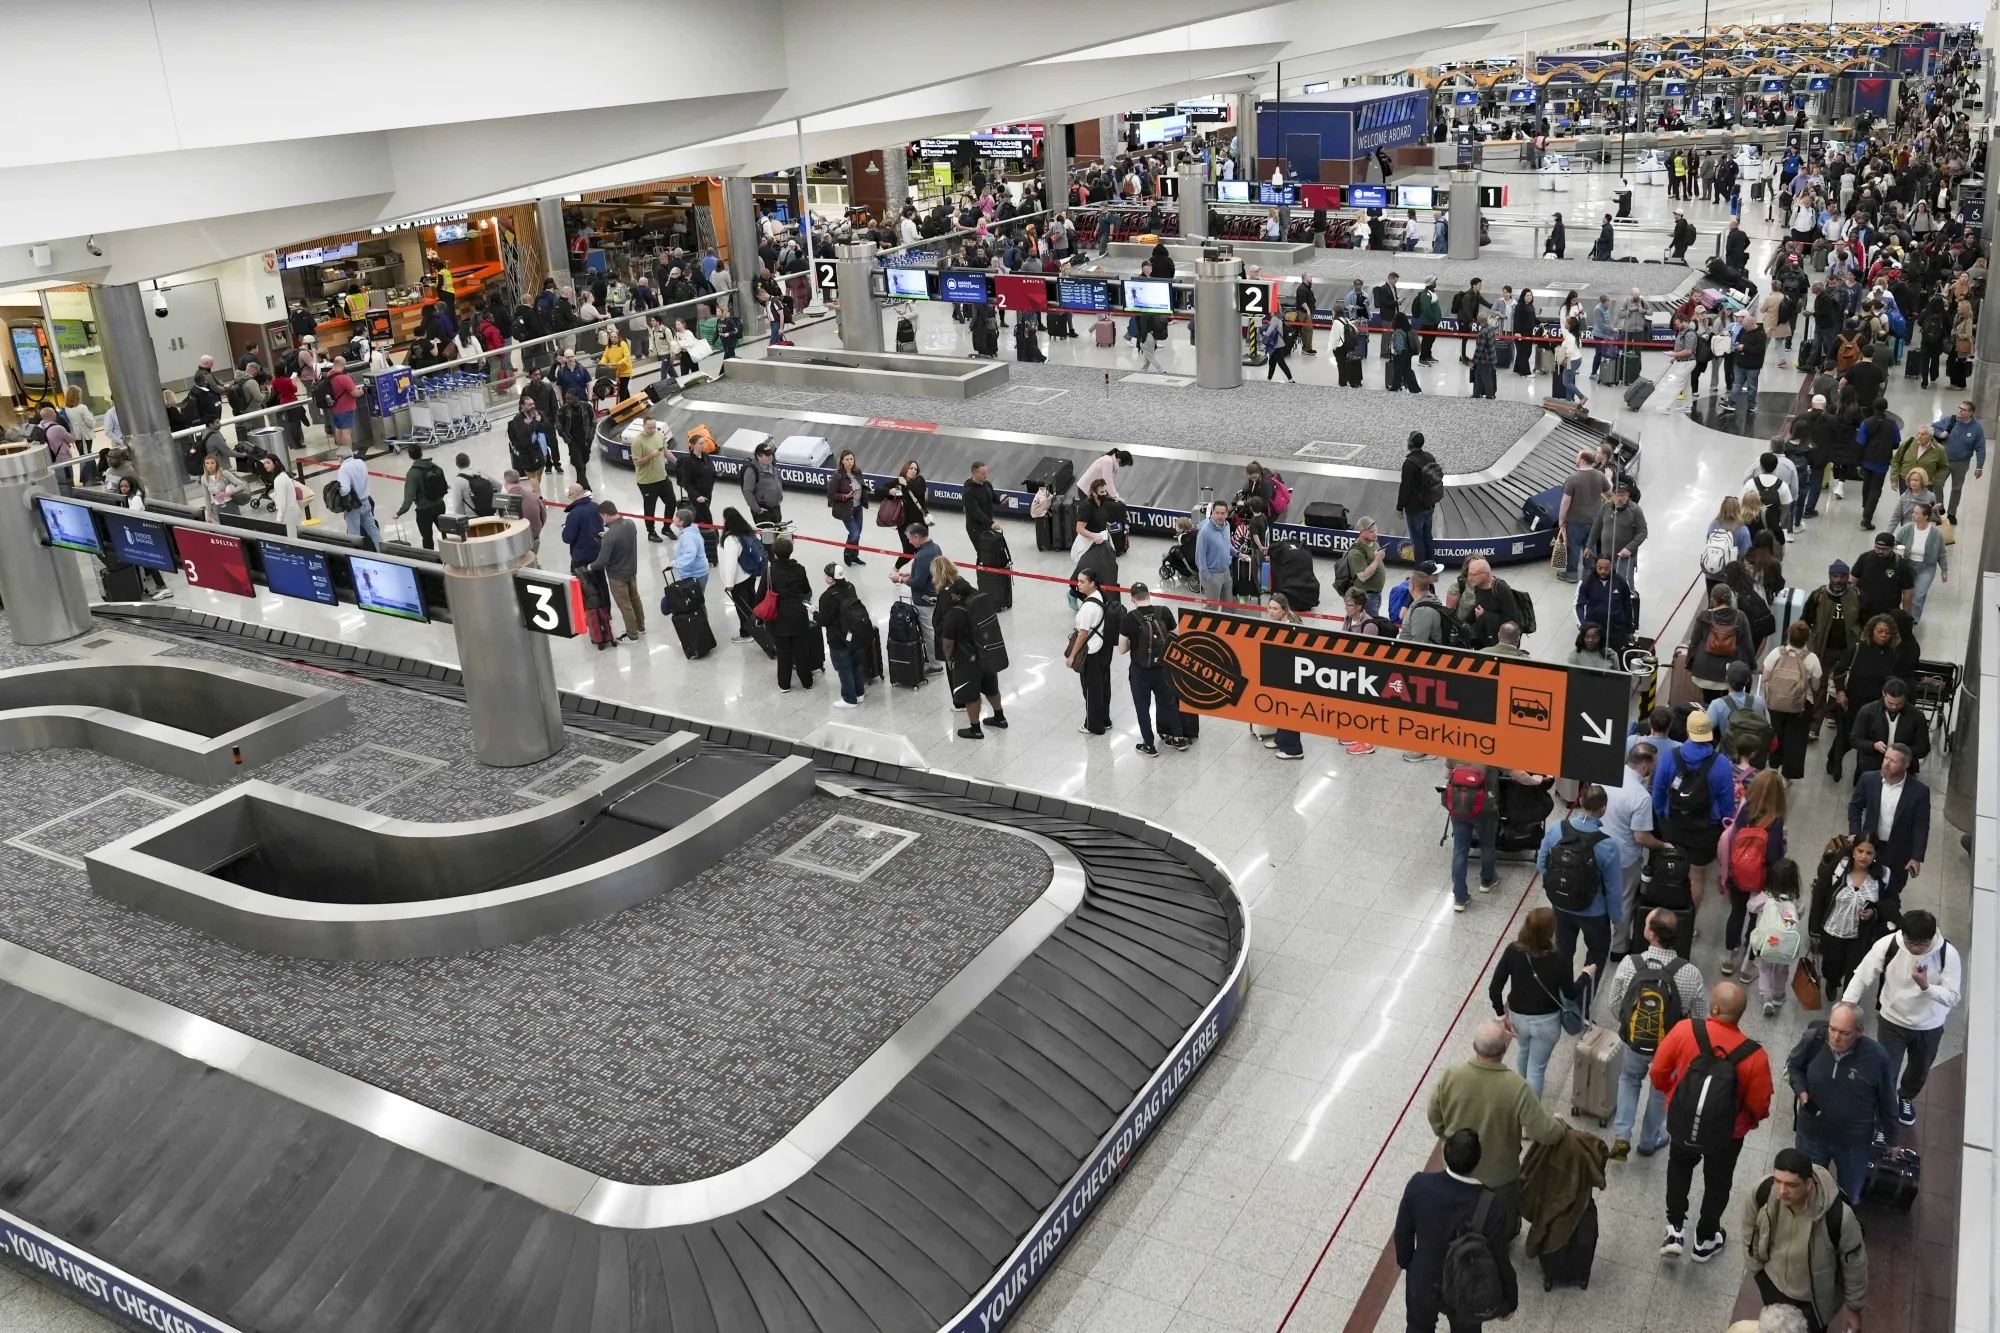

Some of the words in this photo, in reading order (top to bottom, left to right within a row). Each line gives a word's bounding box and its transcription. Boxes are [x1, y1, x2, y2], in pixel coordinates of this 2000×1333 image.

[1357, 131, 1387, 150] WELCOME
[1388, 125, 1411, 142] ABOARD
[1165, 178, 1172, 195] 1
[1487, 188, 1495, 206] 1
[1303, 197, 1309, 208] 1
[820, 264, 836, 287] 2
[997, 294, 1007, 308] 2
[1245, 286, 1263, 312] 2
[713, 460, 739, 475] YOUR
[806, 471, 825, 486] BAG
[215, 538, 234, 547] DELTA
[1272, 528, 1297, 542] BAG
[1300, 531, 1331, 548] FLIES
[184, 559, 199, 583] 3
[526, 584, 559, 630] 3
[1170, 648, 1235, 692] DETOUR
[1254, 693, 1390, 734] On-Airport
[1399, 716, 1496, 755] Parking
[980, 1267, 1028, 1333] YOUR
[1030, 1212, 1070, 1276] FIRST
[1072, 1131, 1134, 1219] CHECKED
[1135, 1092, 1160, 1140] BAG
[1161, 1051, 1191, 1106] FLIES
[1191, 1015, 1219, 1061] FREE
[6, 1230, 61, 1277] YOUR
[59, 1256, 110, 1303] FIRST
